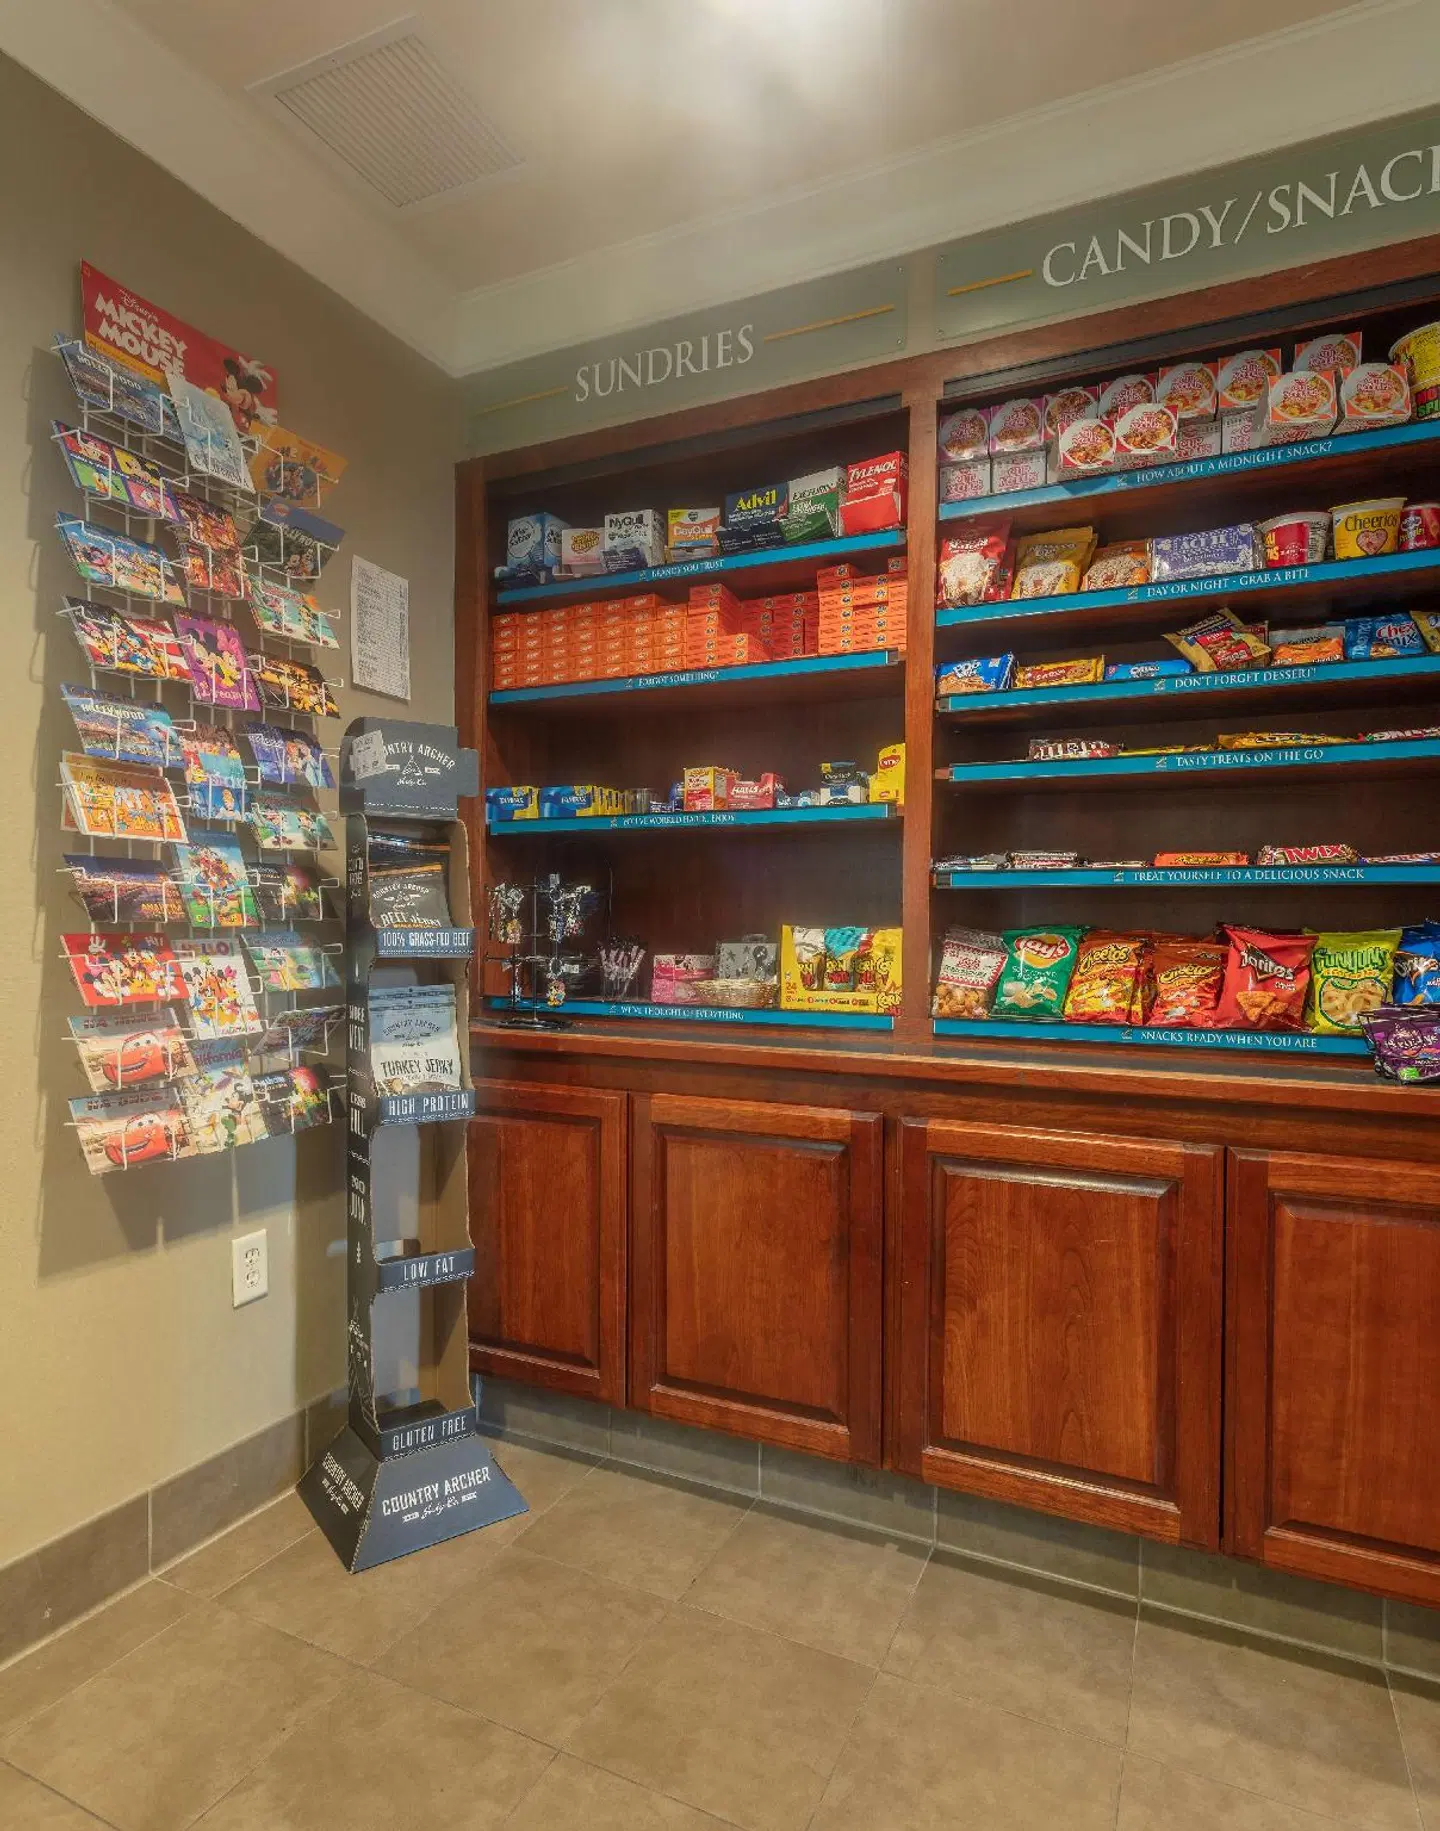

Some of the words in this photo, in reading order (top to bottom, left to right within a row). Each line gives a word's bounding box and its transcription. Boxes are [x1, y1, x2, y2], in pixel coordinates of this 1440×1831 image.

[94, 292, 188, 360] MICKEY
[98, 317, 186, 378] MOUSE
[575, 324, 755, 402] SUNDRIES
[849, 458, 897, 482] TYLENOL
[1137, 470, 1164, 483] HOW
[1166, 463, 1205, 478] ABOUT
[1207, 461, 1216, 471] A
[1218, 449, 1285, 470] MIDNIGHT
[1286, 441, 1332, 459] SNACK?
[736, 489, 776, 511] Advil
[609, 513, 644, 529] NyQuil
[1344, 512, 1399, 532] Cheerios
[1147, 584, 1168, 598] DAY
[1170, 582, 1187, 594] OR
[1190, 578, 1229, 592] NIGHT
[1239, 572, 1267, 586] GRAB
[1270, 572, 1281, 583] A
[1374, 621, 1415, 639] Chex
[1175, 674, 1211, 688] DON'T
[1213, 671, 1259, 686] FORGET
[418, 743, 456, 770] ARCHER
[1175, 755, 1208, 767] TASTY
[1210, 753, 1251, 766] TREATS
[1254, 751, 1271, 763] ON
[1276, 749, 1301, 762] THE
[1303, 749, 1323, 760] GO
[1284, 845, 1342, 862] TWIX
[1134, 871, 1164, 881] TREAT
[1167, 871, 1222, 881] YOURSELF
[1226, 871, 1242, 880] TO
[1243, 870, 1252, 879] A
[1255, 869, 1320, 880] DELICIOUS
[1323, 869, 1364, 879] SNACK
[382, 932, 406, 947] 100%
[408, 932, 450, 946] GRASS-FED
[452, 932, 470, 946] BEEF
[1078, 943, 1132, 975] Cheetos
[1240, 950, 1295, 981] Doritos
[644, 1006, 681, 1016] THOUGHT
[695, 1009, 744, 1020] EVERYTHING
[1140, 1030, 1183, 1042] SNACKS
[1186, 1032, 1222, 1044] READY
[1225, 1034, 1264, 1046] WHEN
[1266, 1035, 1292, 1047] YOU
[1294, 1037, 1318, 1048] ARE
[380, 1060, 421, 1077] TURKEY
[424, 1058, 454, 1075] JERKY
[389, 1098, 416, 1116] HIGH
[422, 1093, 470, 1113] PROTEIN
[403, 1261, 428, 1281] LOW
[435, 1256, 455, 1275] FAT
[393, 1424, 435, 1451] GLUTEN
[442, 1414, 467, 1437] FREE
[382, 1481, 440, 1517] COUNTRY
[443, 1466, 492, 1499] ARCHER
